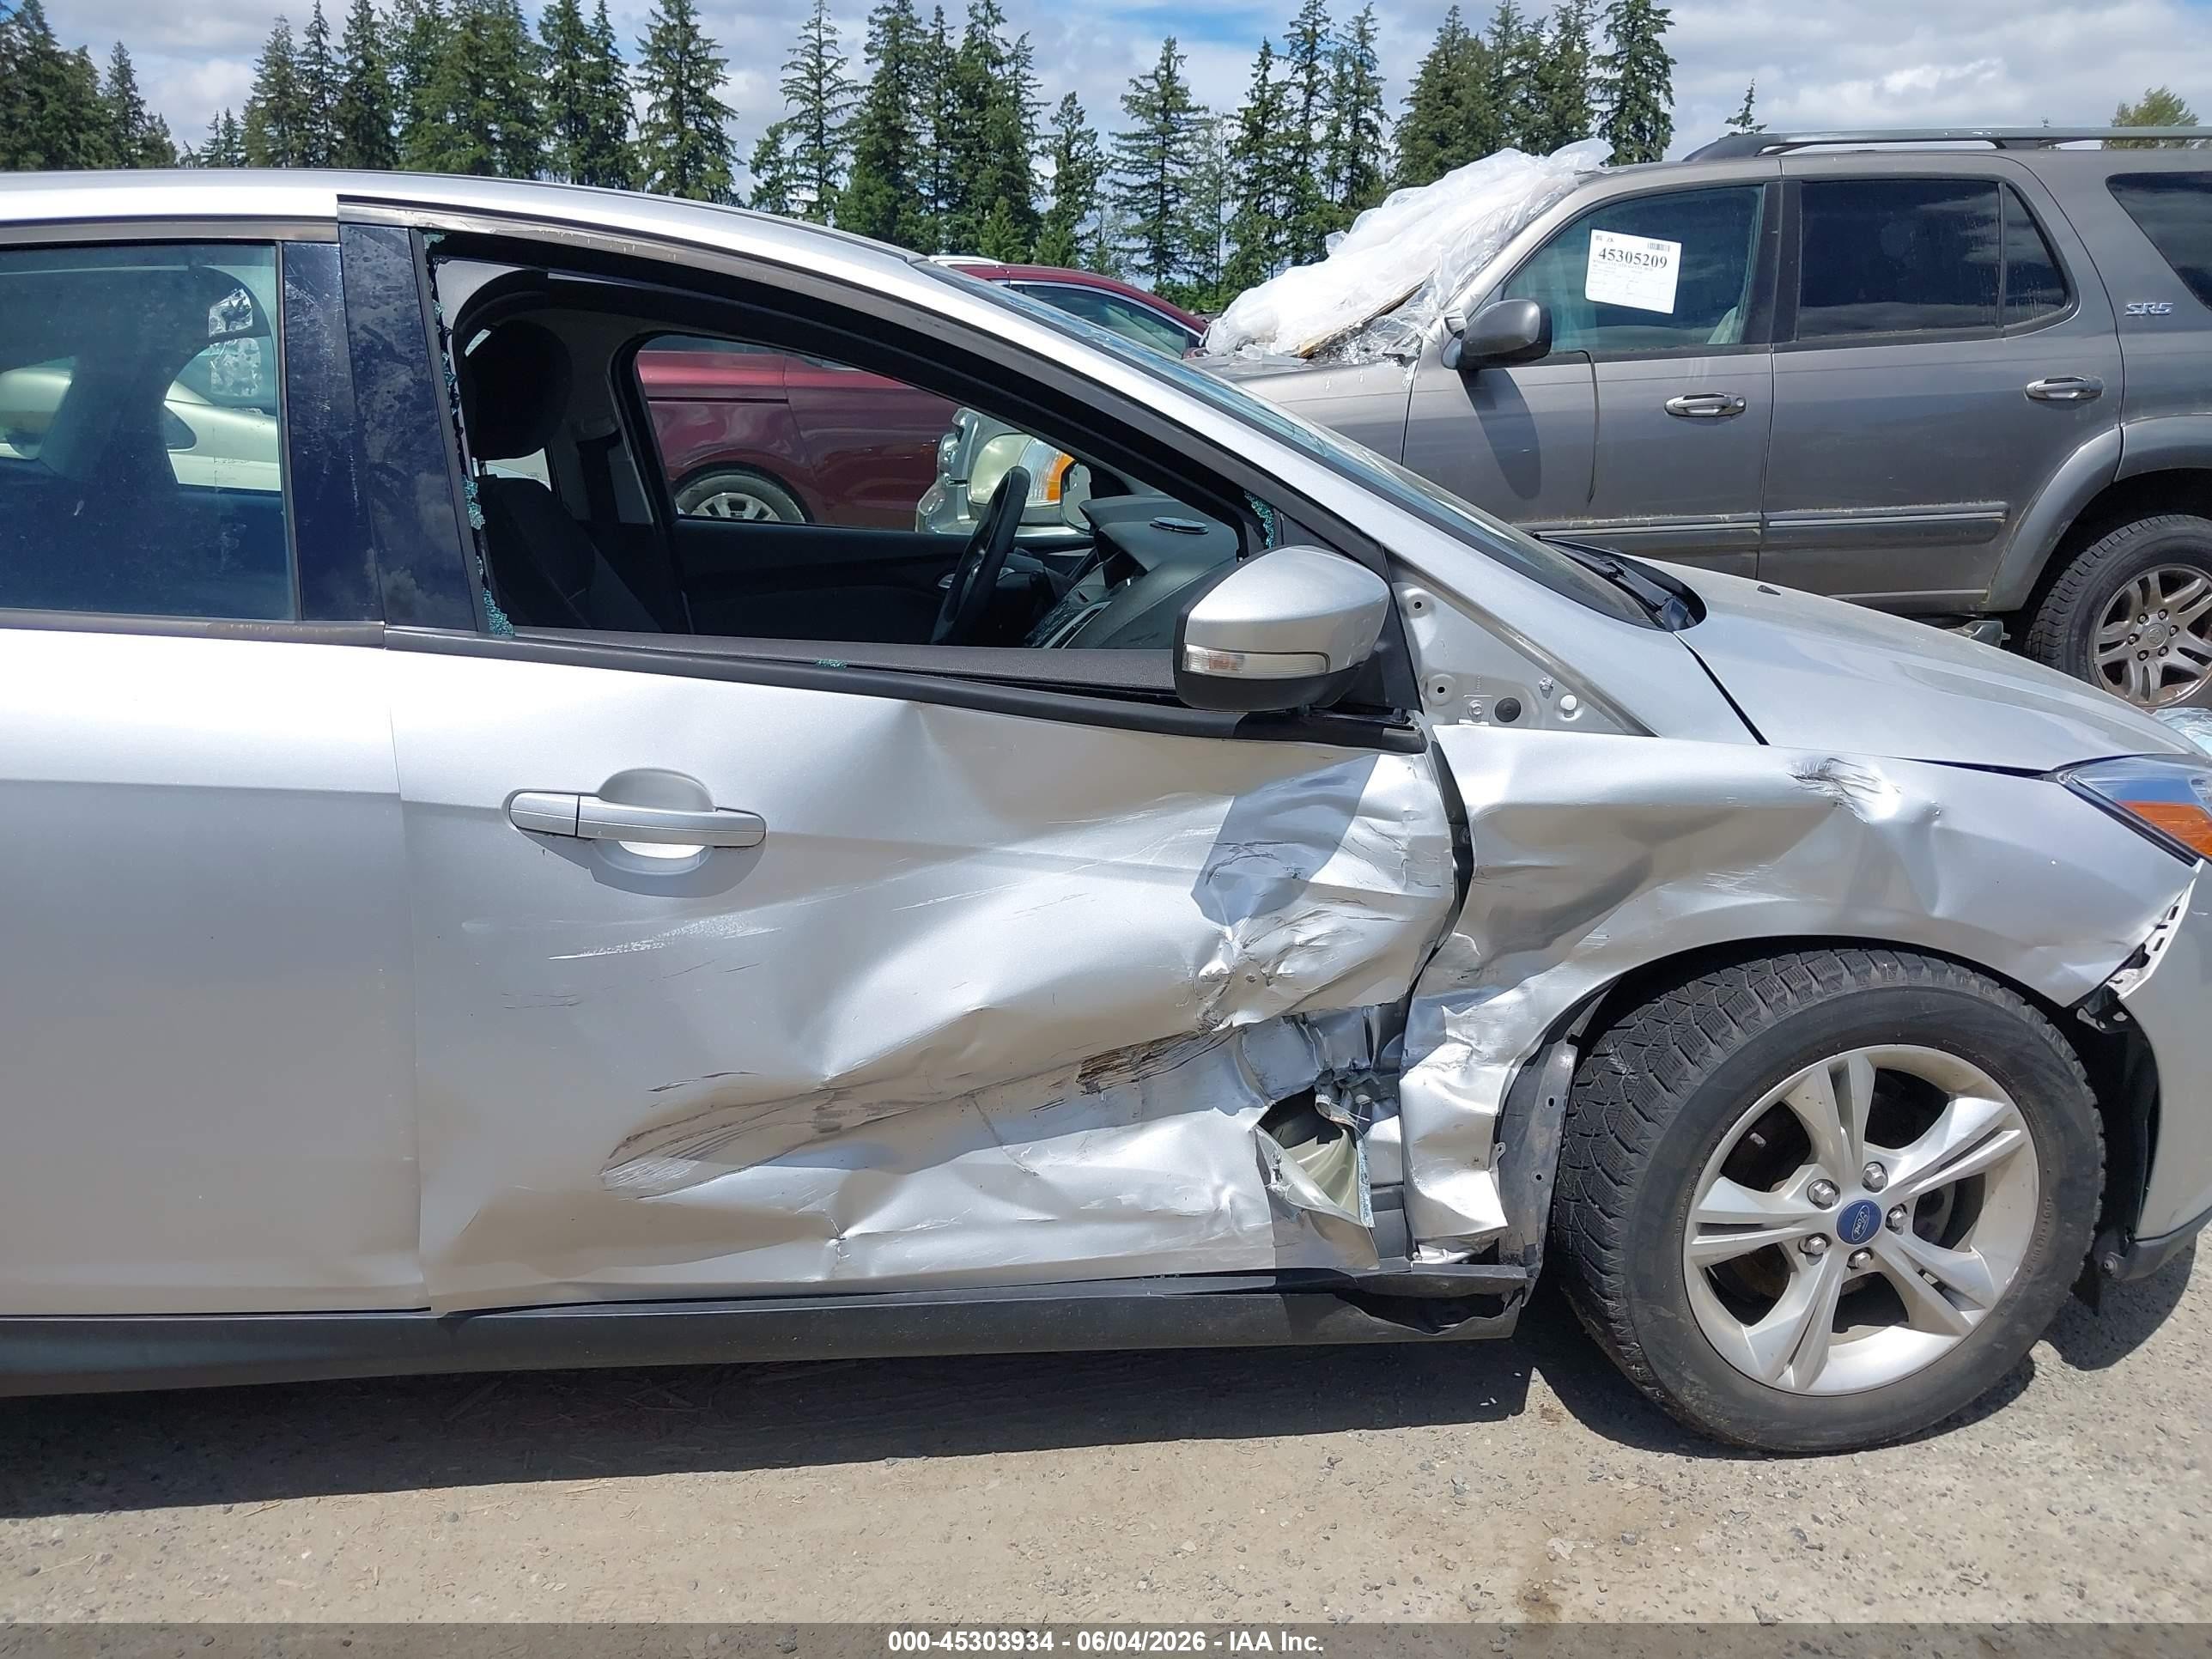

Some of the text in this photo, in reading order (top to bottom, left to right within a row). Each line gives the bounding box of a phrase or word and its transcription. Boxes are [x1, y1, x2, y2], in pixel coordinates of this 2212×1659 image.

[1598, 247, 1668, 269] 45305209
[2124, 302, 2174, 316] SR5
[1854, 1211, 1869, 1235] Ford
